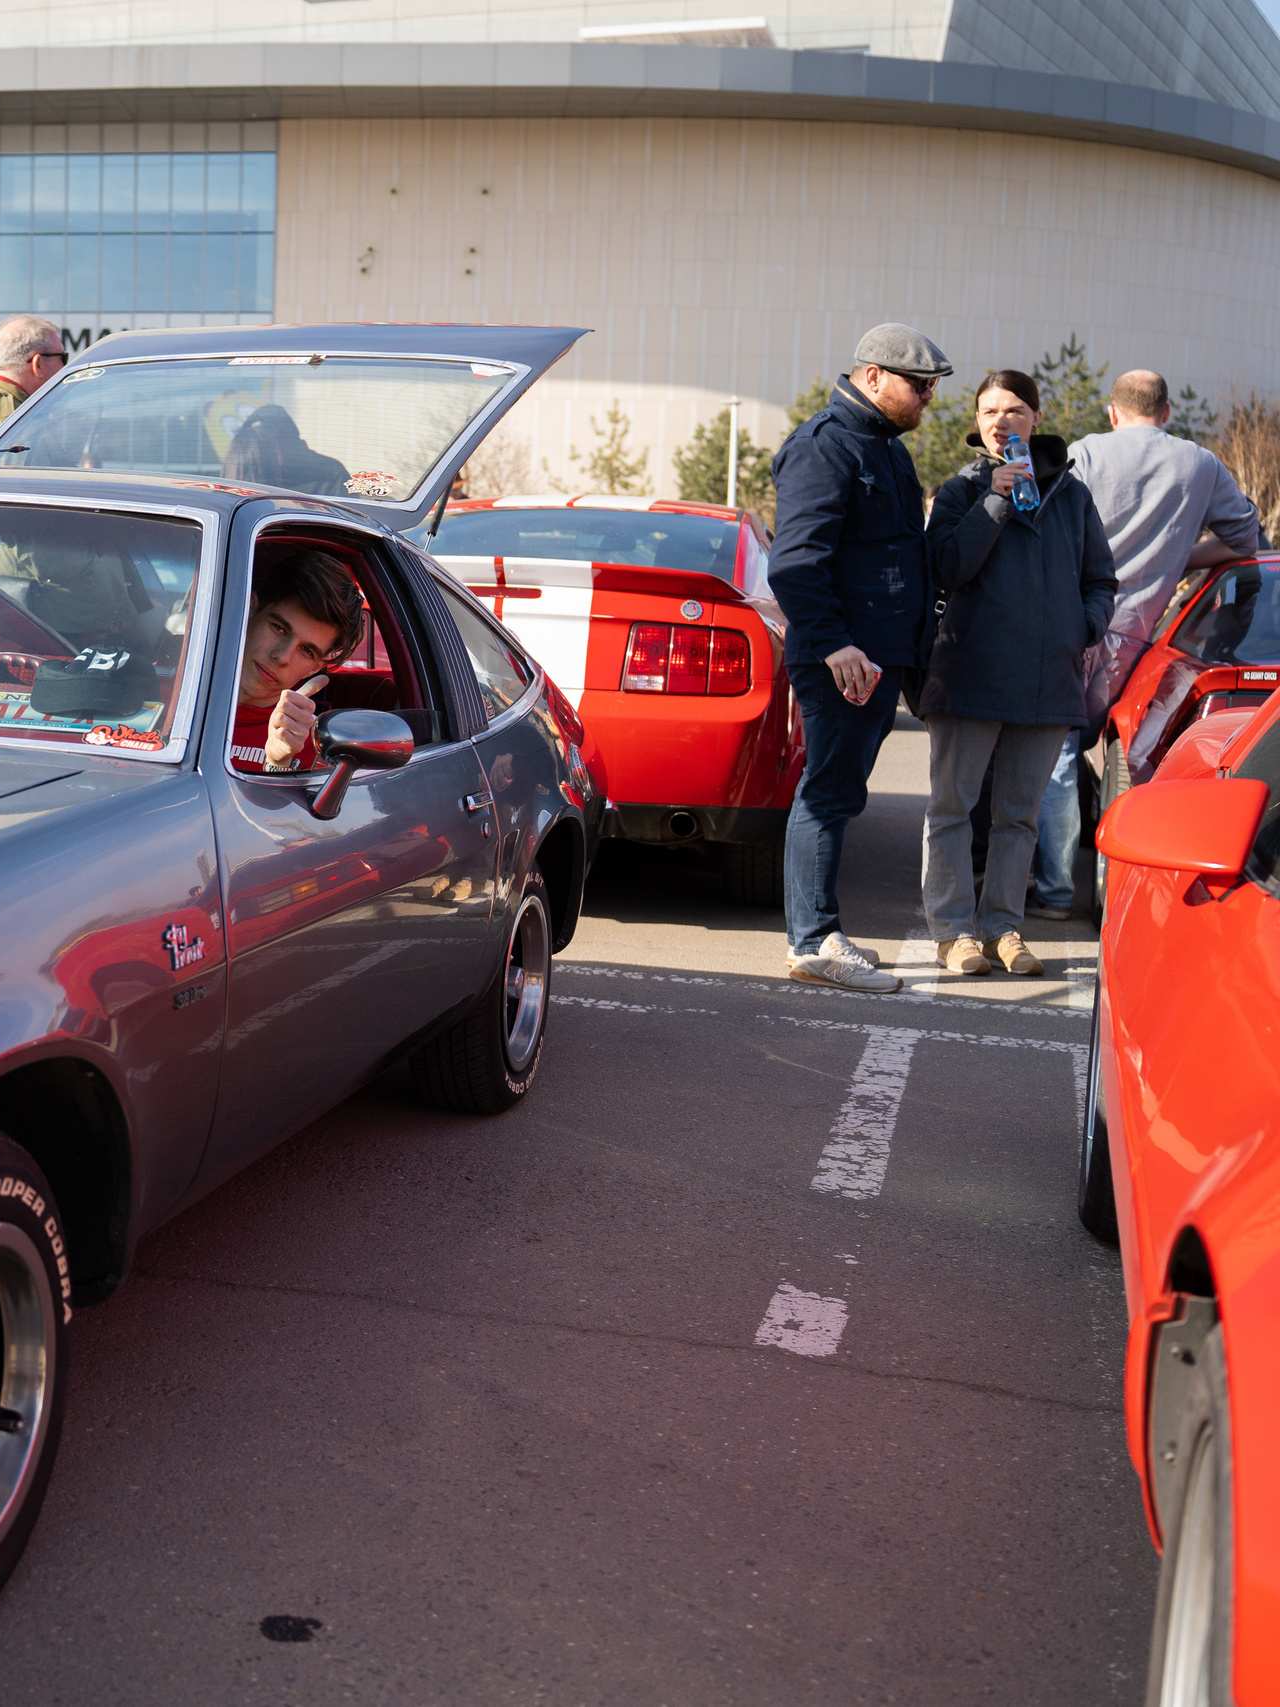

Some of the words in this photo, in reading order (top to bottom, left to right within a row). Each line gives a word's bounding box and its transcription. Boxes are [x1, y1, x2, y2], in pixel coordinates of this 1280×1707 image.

[74, 647, 131, 671] FBI
[120, 739, 155, 751] CHAINS
[230, 744, 266, 764] PUM
[824, 960, 853, 983] N
[505, 1071, 525, 1094] COBRA
[43, 1215, 73, 1325] COBRA
